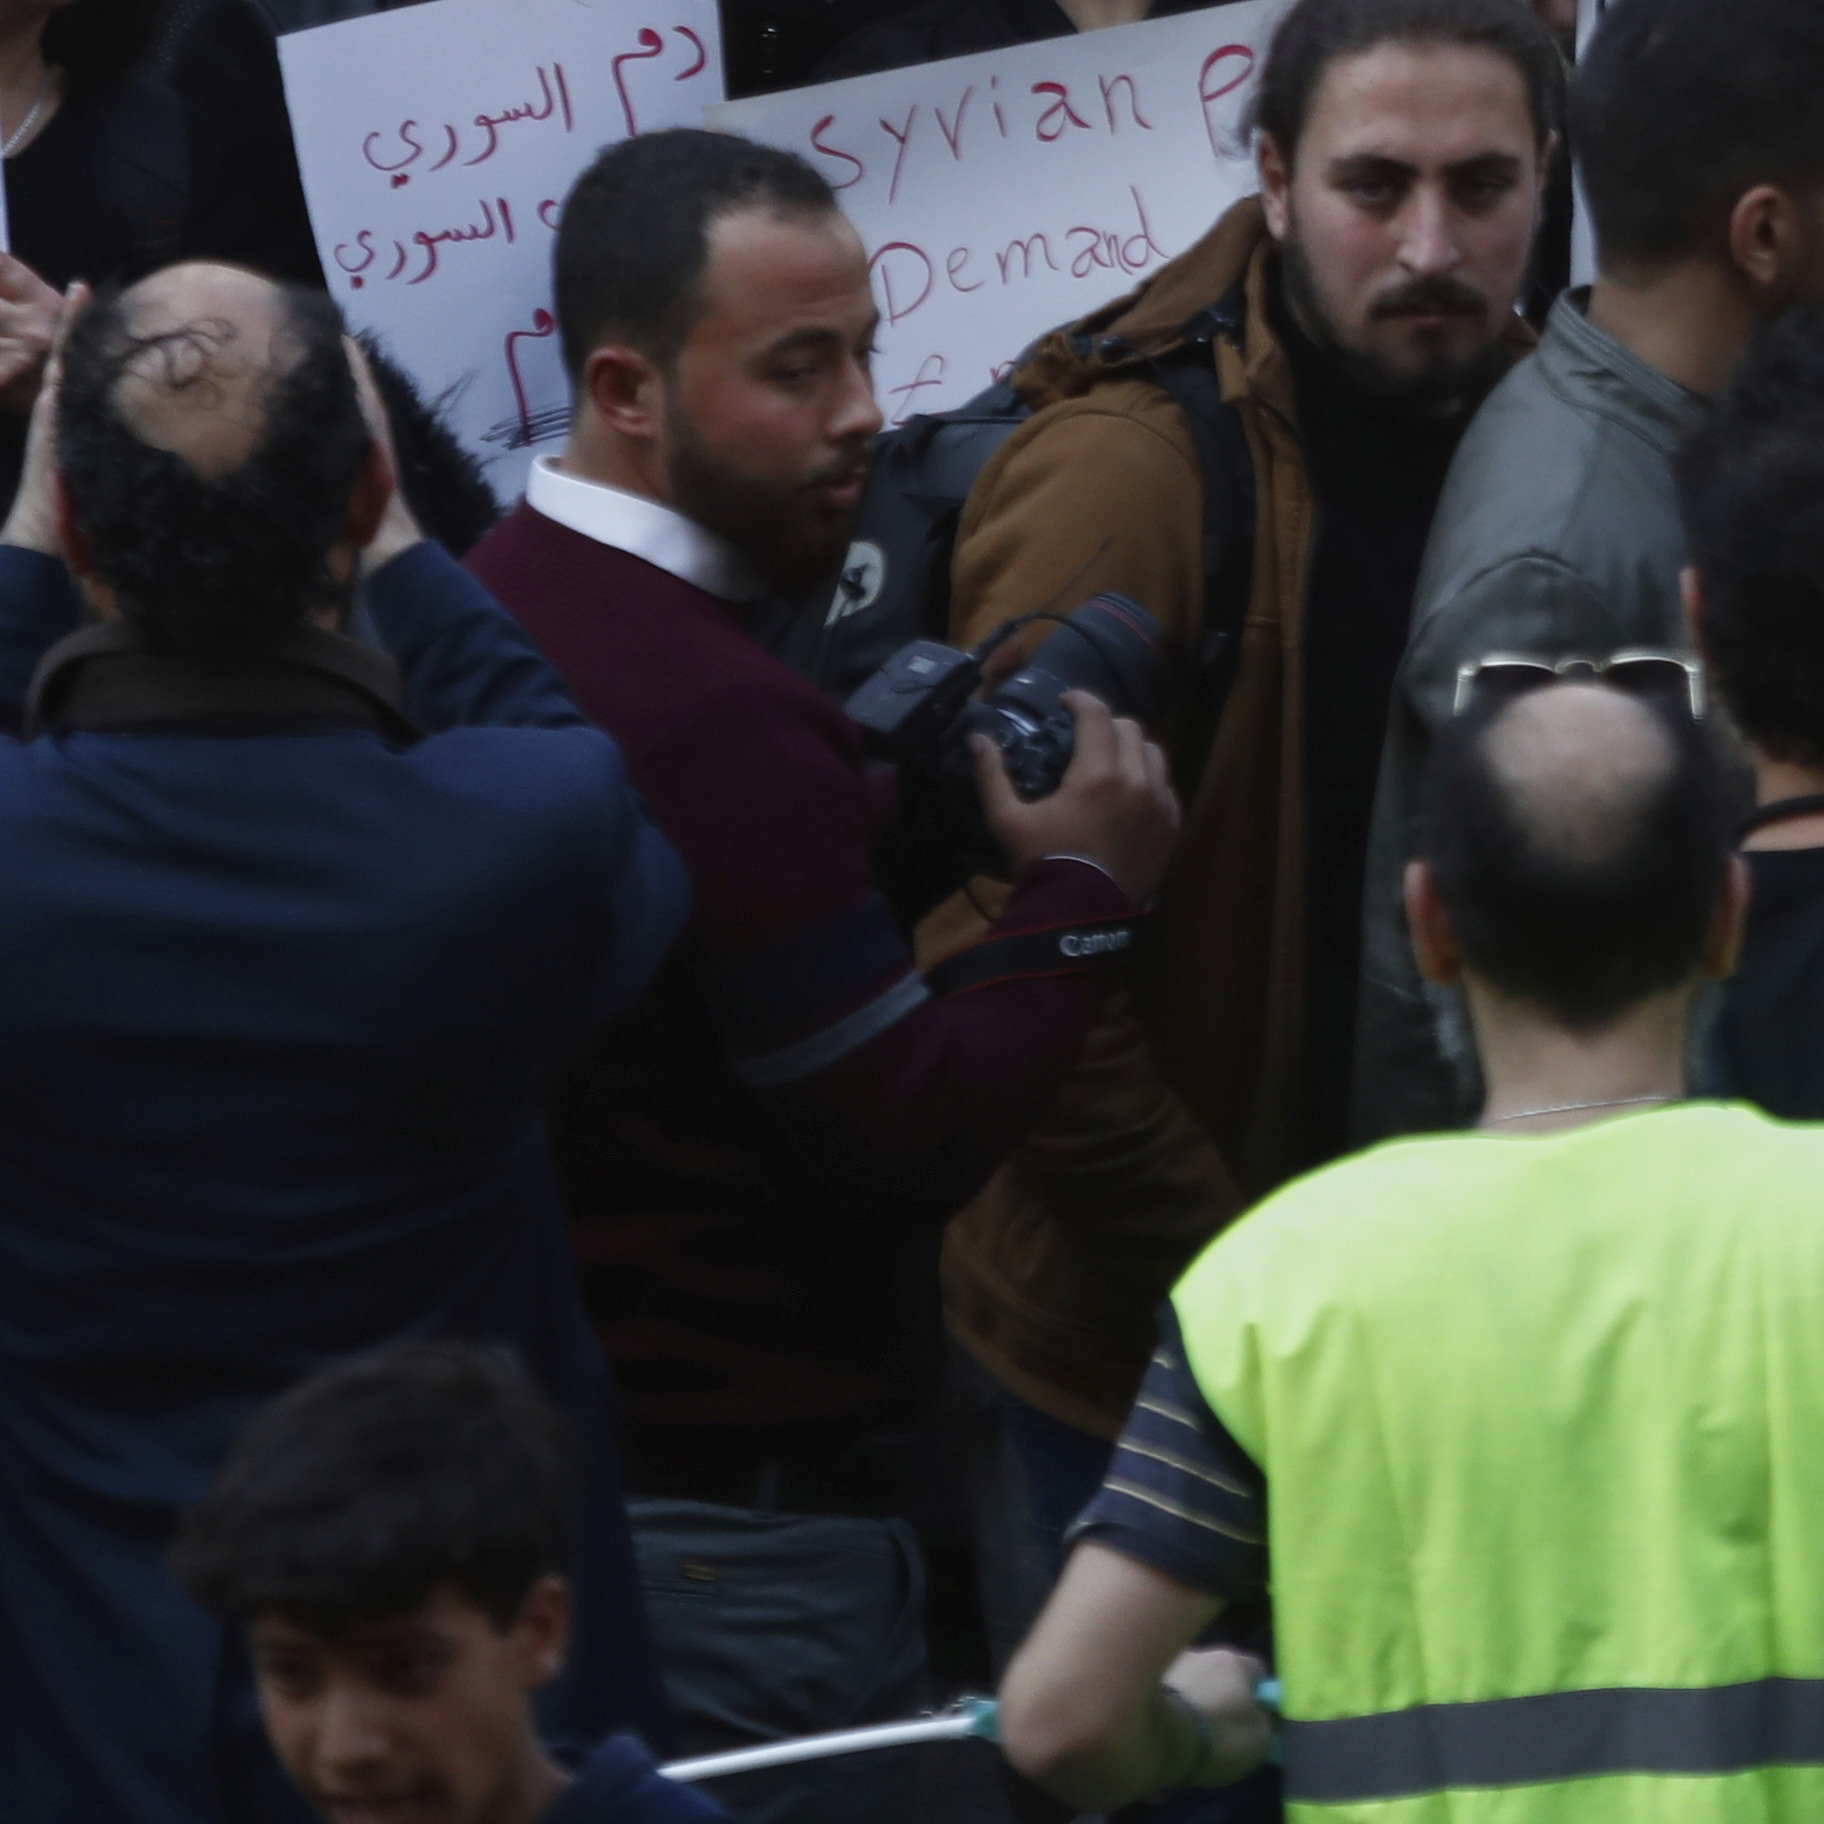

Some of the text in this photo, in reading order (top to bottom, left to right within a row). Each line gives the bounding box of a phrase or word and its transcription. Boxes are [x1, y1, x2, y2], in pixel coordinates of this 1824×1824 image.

[362, 24, 705, 188] دم السوري
[334, 196, 515, 289] السوري
[869, 185, 1172, 326] Demand
